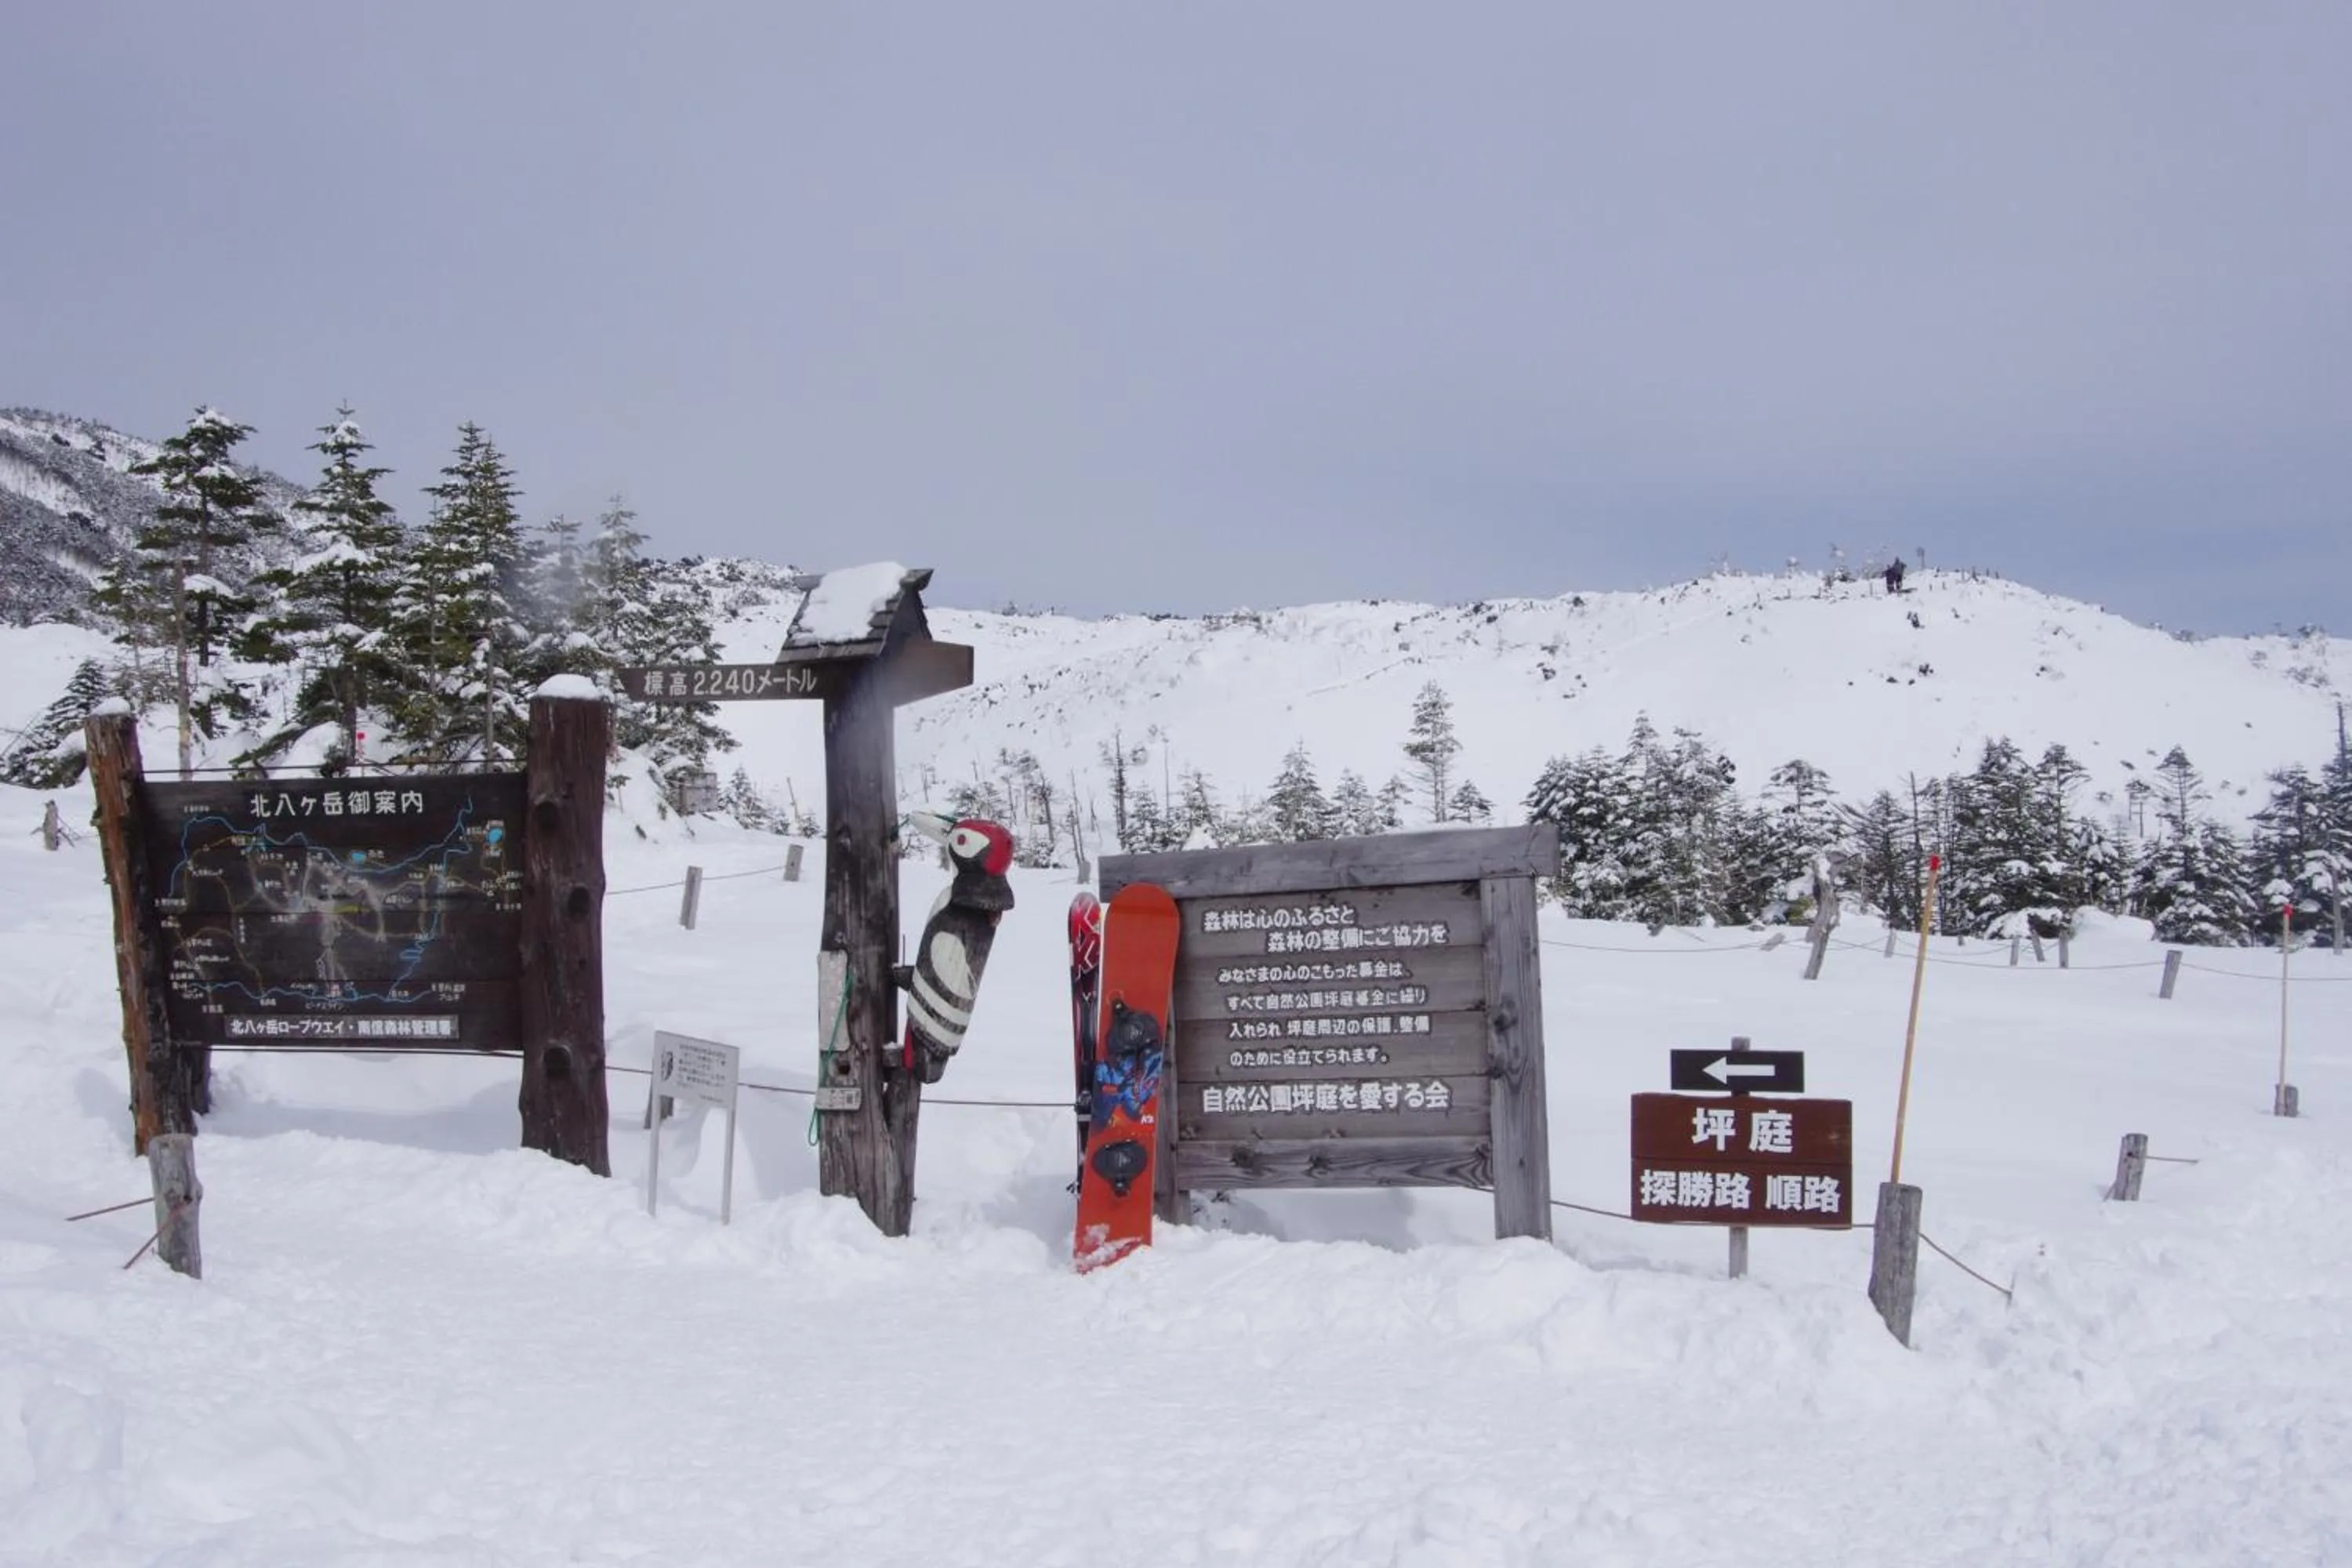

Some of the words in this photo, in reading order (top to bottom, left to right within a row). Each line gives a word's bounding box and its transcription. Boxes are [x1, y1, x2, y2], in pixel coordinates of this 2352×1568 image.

[1203, 906, 1354, 931] 森林は心のふるさと
[1268, 925, 1447, 953] 森林の整備にご協力を
[1203, 1082, 1450, 1112] 自然公園坪庭を愛する会
[1640, 1169, 1751, 1208] 探勝路
[1766, 1174, 1841, 1213] 順路
